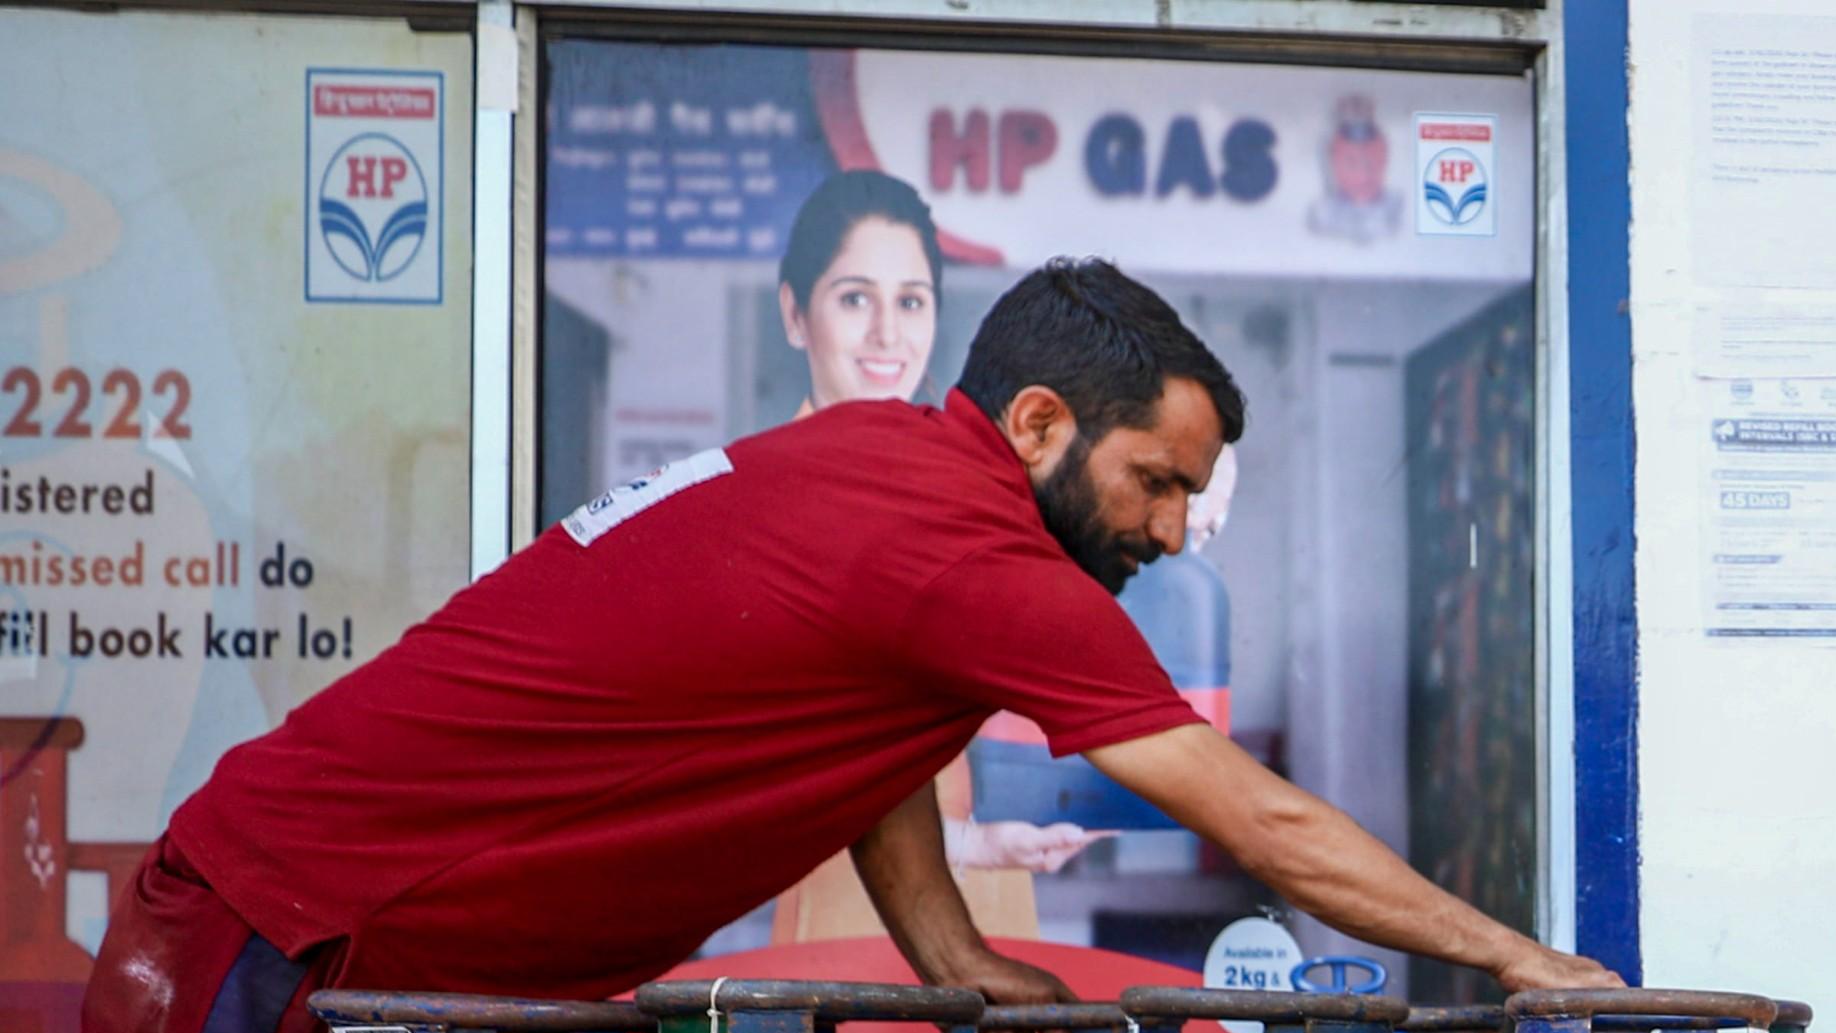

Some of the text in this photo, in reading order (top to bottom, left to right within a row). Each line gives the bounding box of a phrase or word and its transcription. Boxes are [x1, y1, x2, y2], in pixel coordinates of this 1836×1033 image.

[927, 108, 1280, 203] HP GAS
[1440, 160, 1474, 182] HP
[347, 156, 407, 198] HP
[1748, 493, 1786, 507] DAYS
[164, 542, 240, 588] call
[260, 541, 314, 588] do
[70, 611, 183, 659] book
[205, 612, 280, 659] kar
[299, 612, 354, 660] lo!
[1223, 946, 1287, 960] Available in
